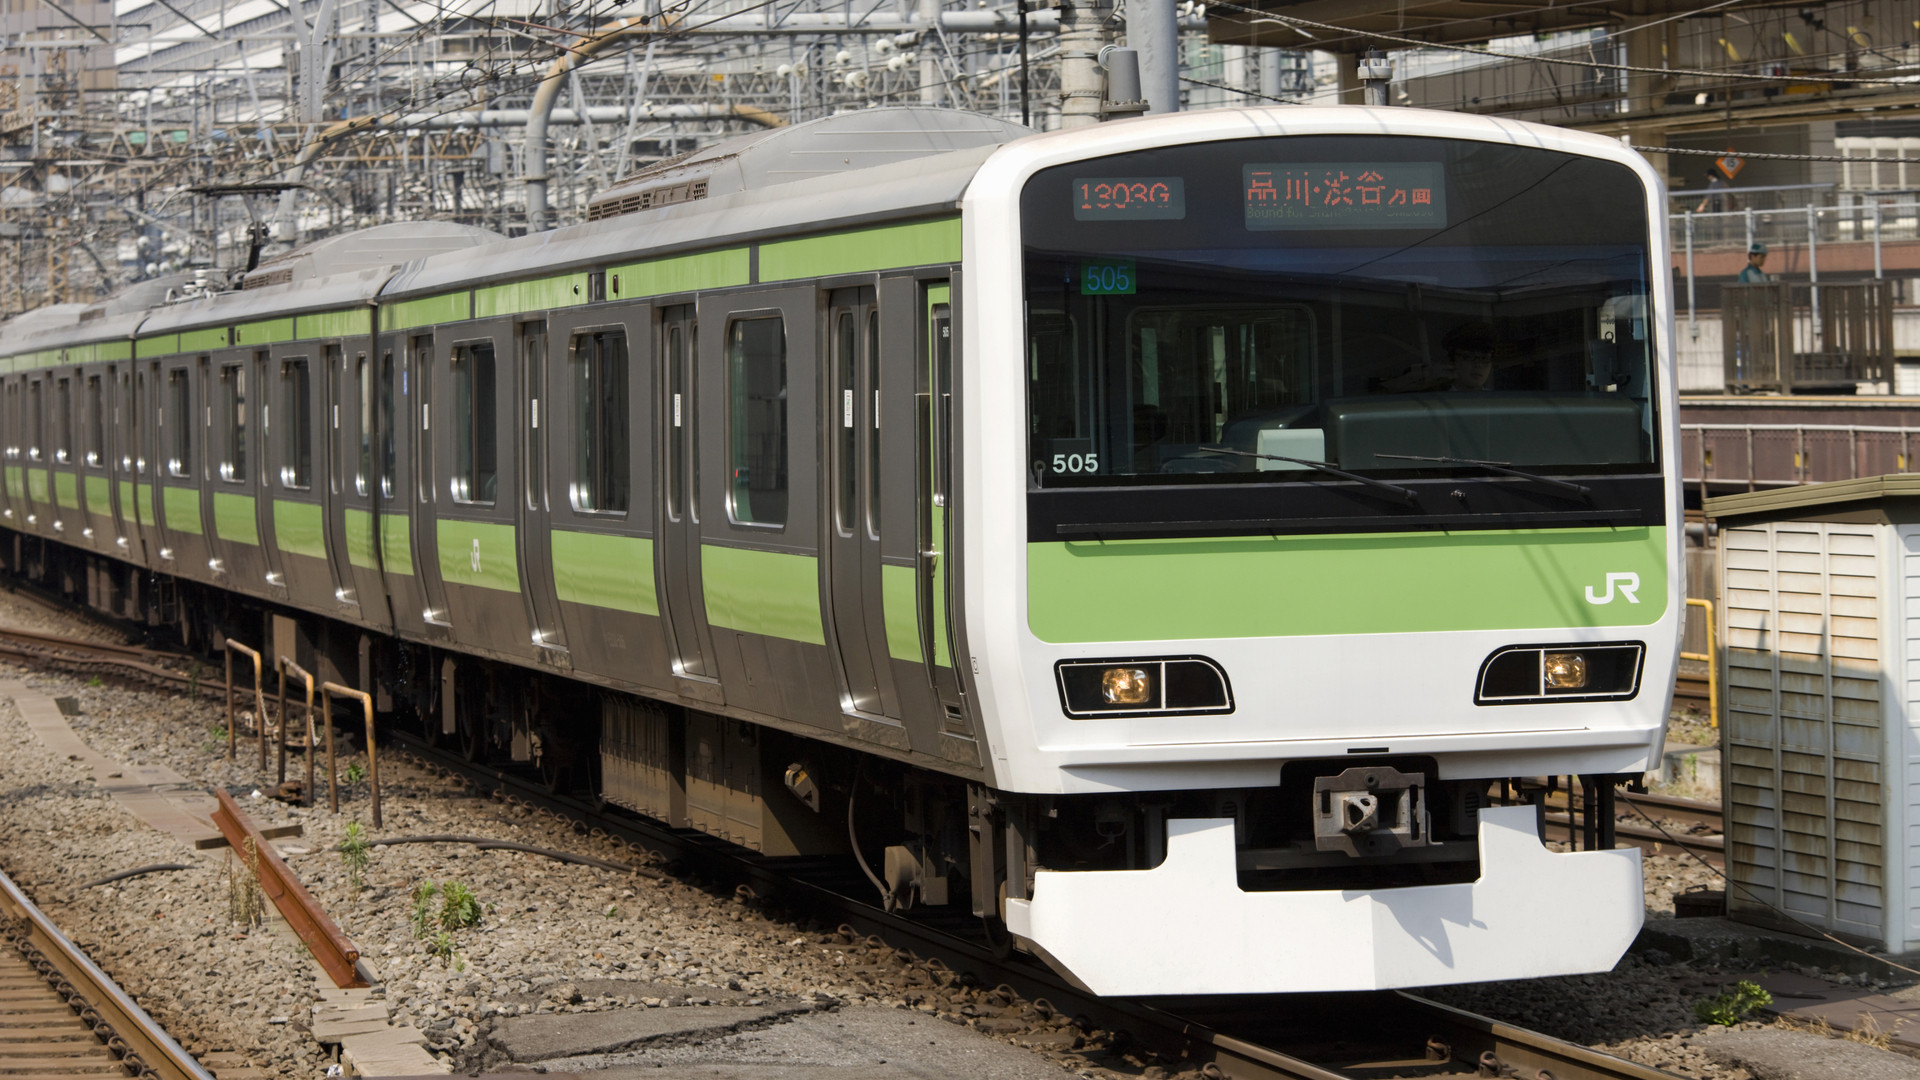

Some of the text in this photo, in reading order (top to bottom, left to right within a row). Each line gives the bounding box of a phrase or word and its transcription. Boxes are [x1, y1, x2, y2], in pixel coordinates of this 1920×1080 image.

[1081, 183, 1170, 209] 1303G
[1247, 206, 1283, 219] Bound
[1087, 266, 1130, 291] 505
[1052, 453, 1099, 474] 505
[470, 538, 482, 573] JR
[1585, 571, 1641, 605] JR
